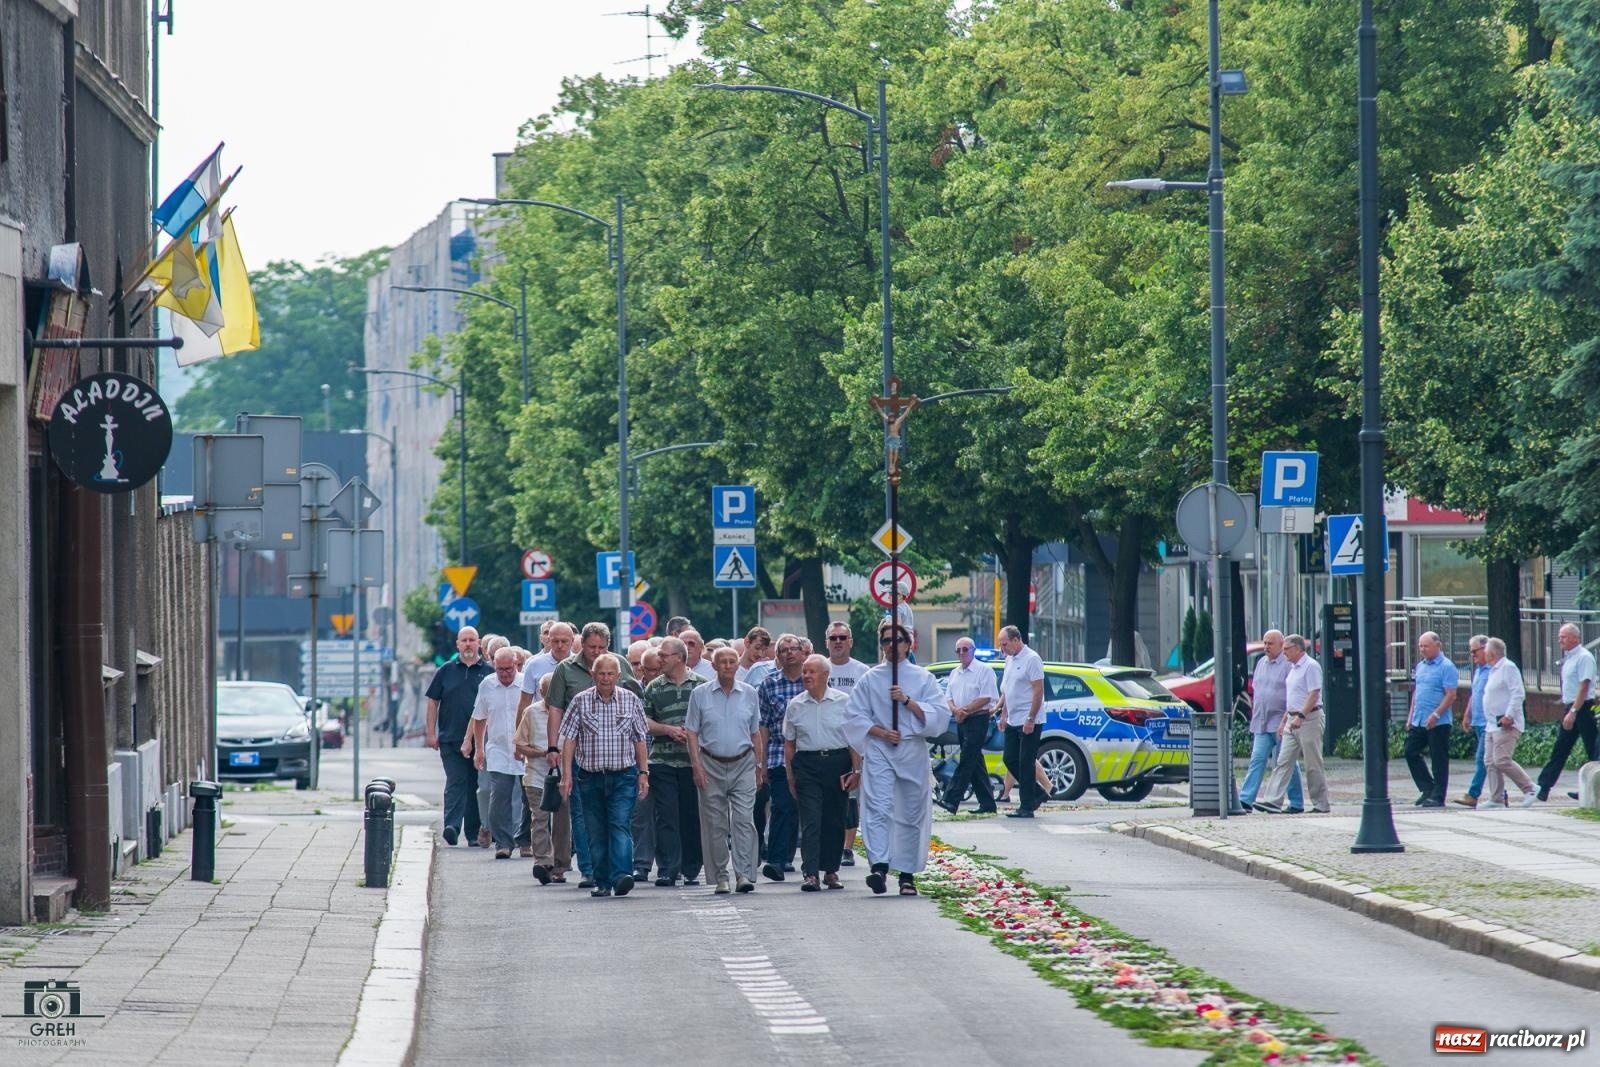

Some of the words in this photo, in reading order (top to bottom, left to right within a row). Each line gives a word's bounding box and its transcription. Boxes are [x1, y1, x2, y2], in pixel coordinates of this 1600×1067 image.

[1274, 458, 1306, 499] P
[723, 490, 746, 523] P
[530, 583, 548, 608] P
[1078, 715, 1103, 726] R522
